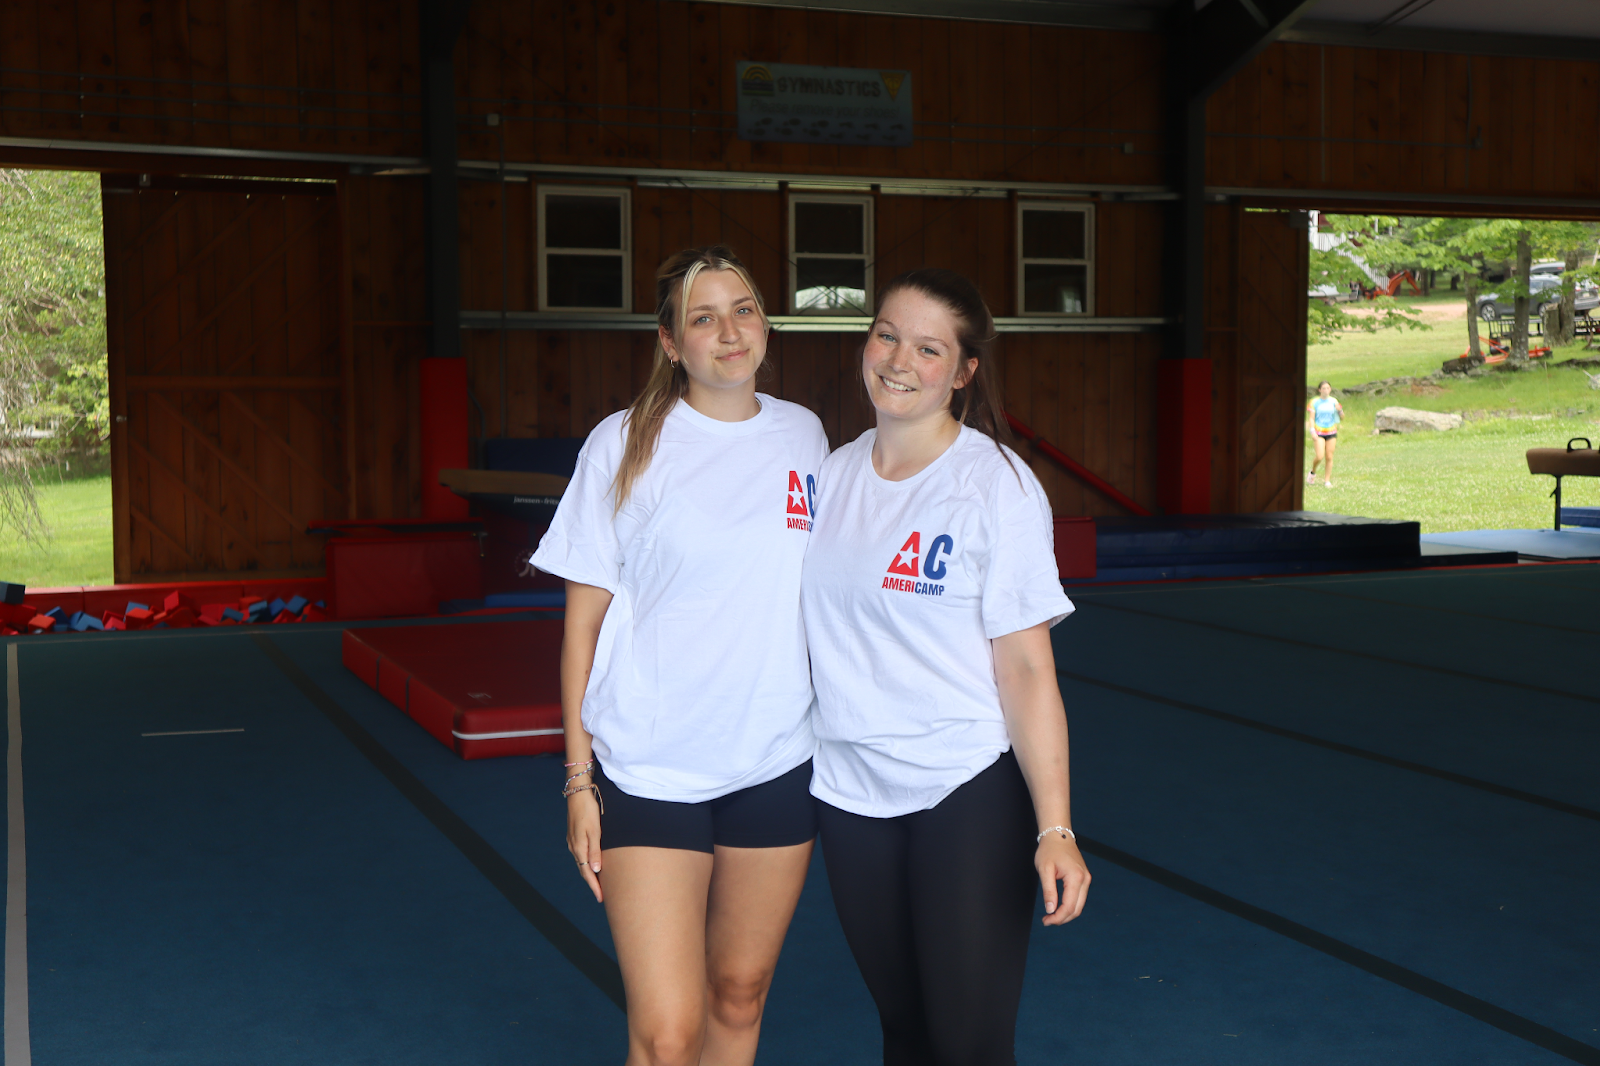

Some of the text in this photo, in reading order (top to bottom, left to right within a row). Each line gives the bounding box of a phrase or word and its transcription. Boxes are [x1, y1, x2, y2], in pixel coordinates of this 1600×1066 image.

[776, 76, 882, 98] GYMNASTICS
[750, 99, 788, 114] Please
[791, 103, 834, 115] remove
[835, 106, 861, 119] your
[886, 531, 954, 581] AC
[881, 576, 945, 596] AMERICAMP
